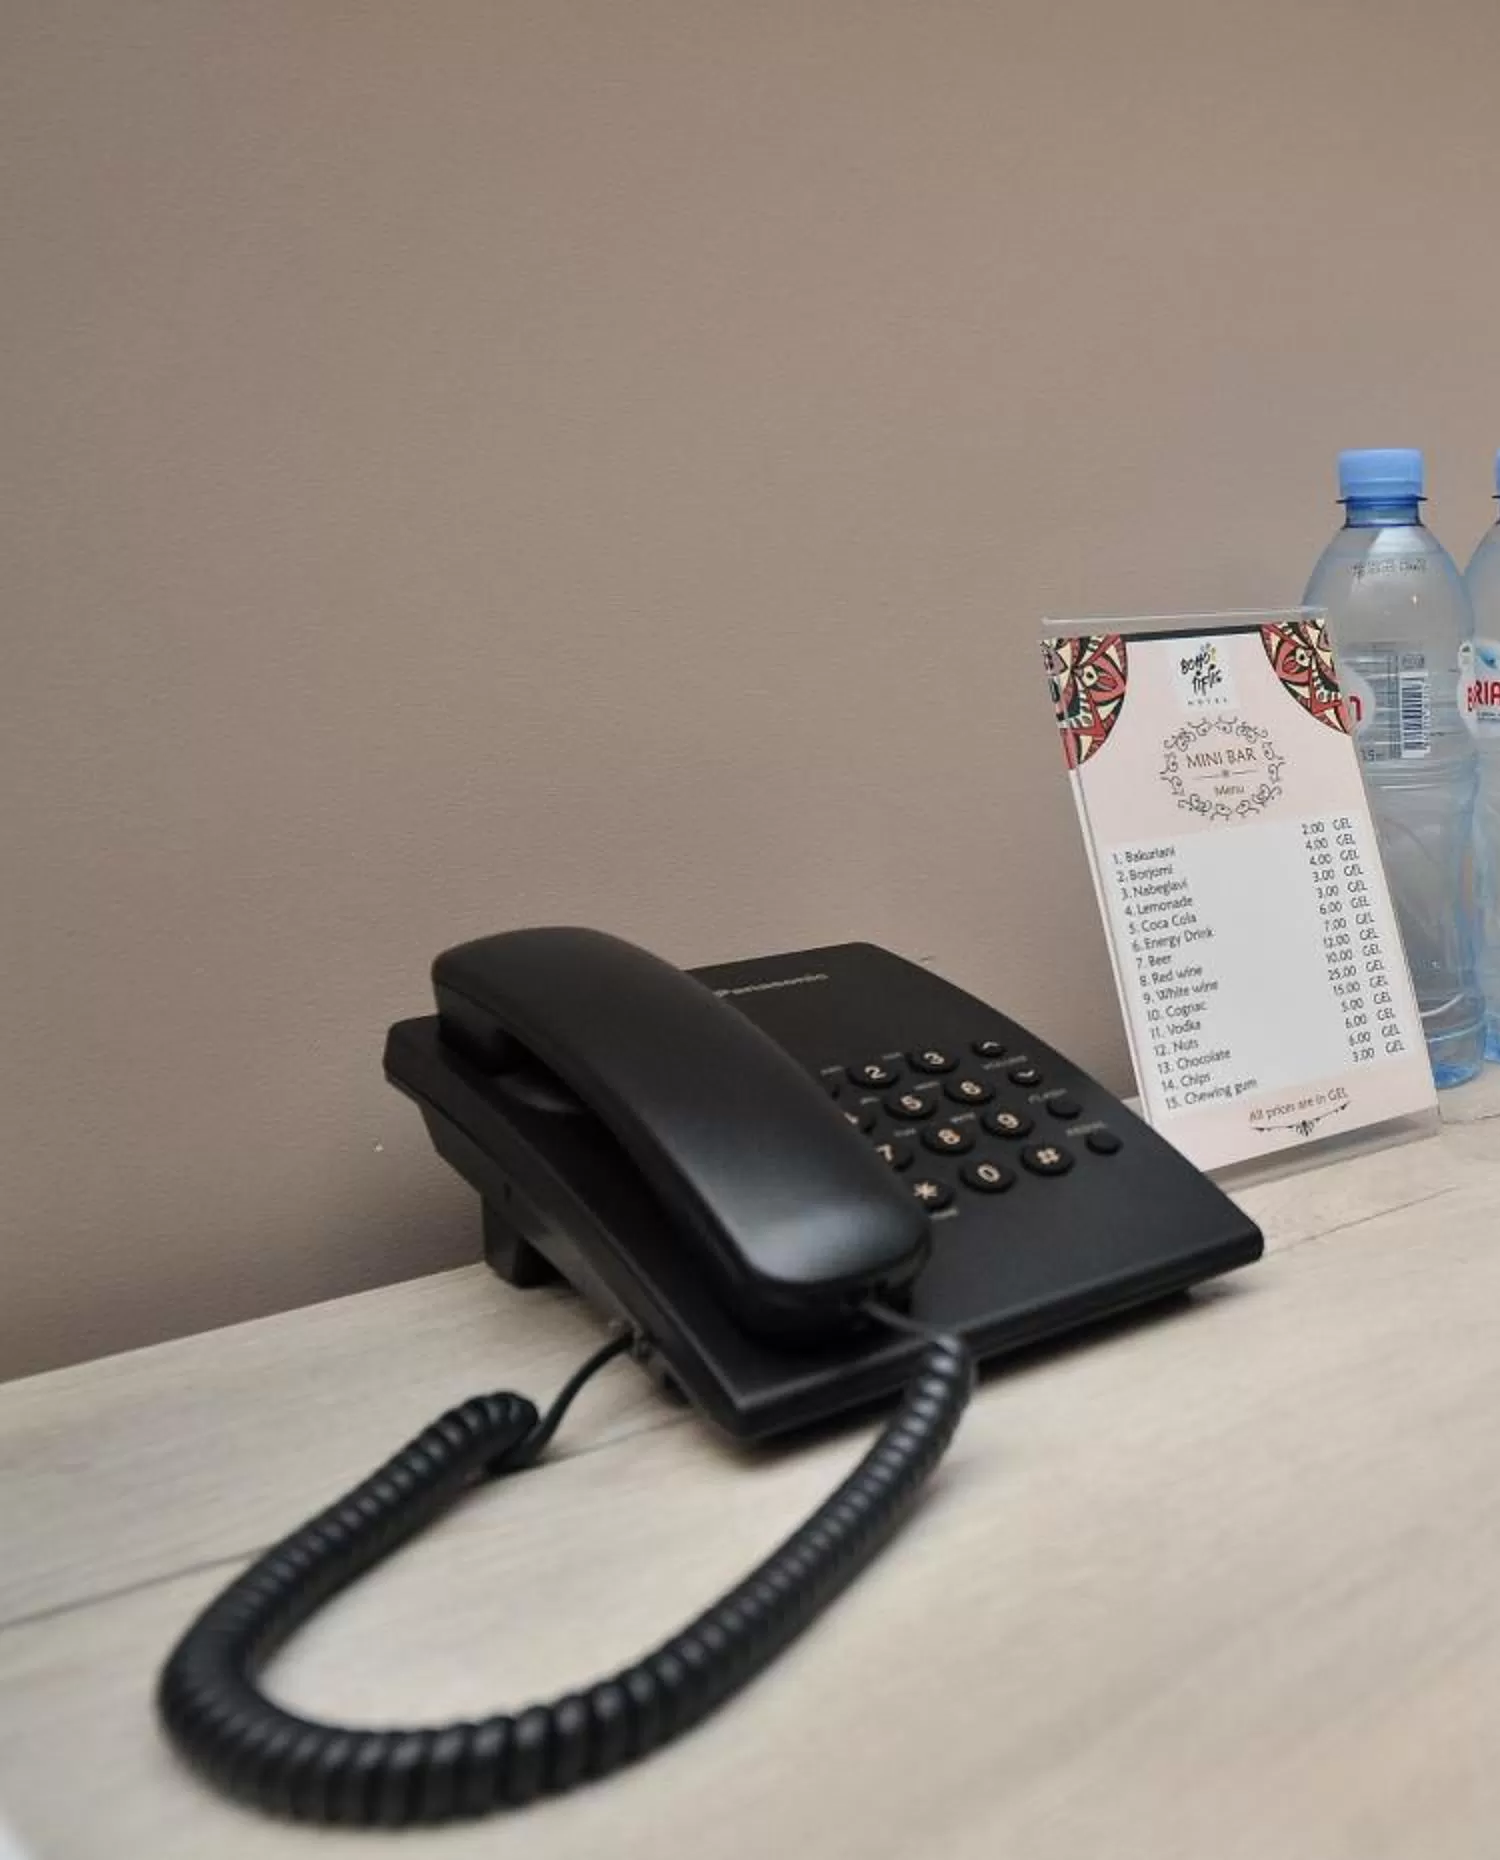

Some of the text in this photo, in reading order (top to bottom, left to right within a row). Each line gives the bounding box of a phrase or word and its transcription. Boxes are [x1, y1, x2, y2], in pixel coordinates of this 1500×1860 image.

[1186, 747, 1257, 769] MINI BAR
[1214, 784, 1245, 797] Menu
[1332, 817, 1352, 831] GEL
[1129, 864, 1172, 881] Borjomi
[1336, 833, 1356, 846] GEL
[1133, 878, 1187, 898] Nabeglavi
[1340, 849, 1360, 861] GEL
[1137, 896, 1192, 915] Lemonade
[1343, 863, 1364, 877] GEL
[1141, 920, 1168, 932] Coca
[1172, 912, 1197, 926] Cola
[1347, 880, 1368, 893] GEL
[1144, 935, 1180, 950] Energy
[1184, 927, 1214, 942] Drink
[1350, 896, 1371, 909] GEL
[1148, 955, 1172, 967] Beer
[1355, 912, 1375, 925] GEL
[1152, 969, 1173, 984] Red
[1175, 966, 1202, 979] wine
[1360, 928, 1380, 941] GEL
[1156, 986, 1189, 1000] White
[1192, 980, 1218, 993] wine
[1362, 943, 1383, 957] GEL
[1166, 1001, 1208, 1018] Cognac
[1365, 959, 1385, 972] GEL
[1167, 1019, 1201, 1036] Vodka
[1369, 975, 1389, 988] GEL
[1174, 1039, 1199, 1052] Nuts
[1373, 991, 1393, 1005] GEL
[1177, 1049, 1232, 1070] Chocolate
[1377, 1007, 1397, 1021] GEL
[864, 1052, 945, 1079] 2 3
[1180, 1073, 1211, 1087] Chips
[1381, 1023, 1401, 1038] GEL
[1184, 1085, 1232, 1104] Chewing
[1234, 1079, 1258, 1095] gum
[1385, 1039, 1406, 1053] GEL
[1265, 1103, 1296, 1120] prices
[1298, 1098, 1314, 1109] are
[1316, 1093, 1326, 1105] in
[1327, 1087, 1349, 1101] GEL
[977, 1164, 1000, 1182] 0
